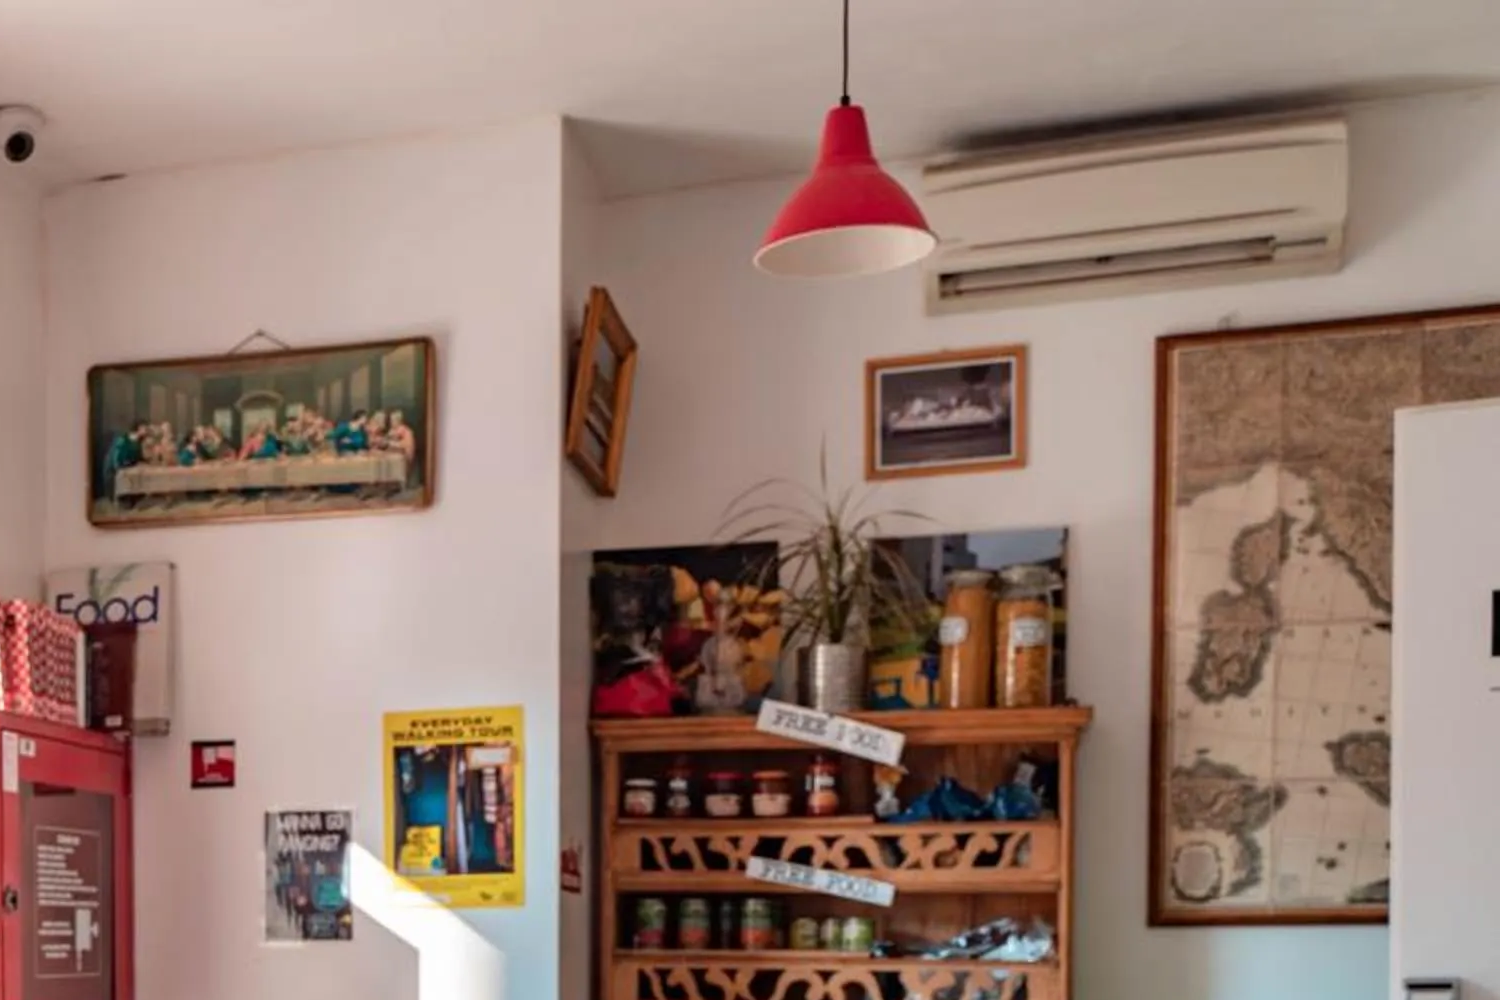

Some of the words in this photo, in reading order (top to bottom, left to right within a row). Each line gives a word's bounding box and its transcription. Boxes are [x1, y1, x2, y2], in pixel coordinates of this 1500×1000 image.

[392, 728, 464, 741] WALKING
[469, 725, 514, 737] TOUR
[410, 716, 493, 728] EVERYDAY
[771, 708, 828, 736] FREE
[762, 859, 814, 884] FREE
[826, 873, 878, 899] FOOD
